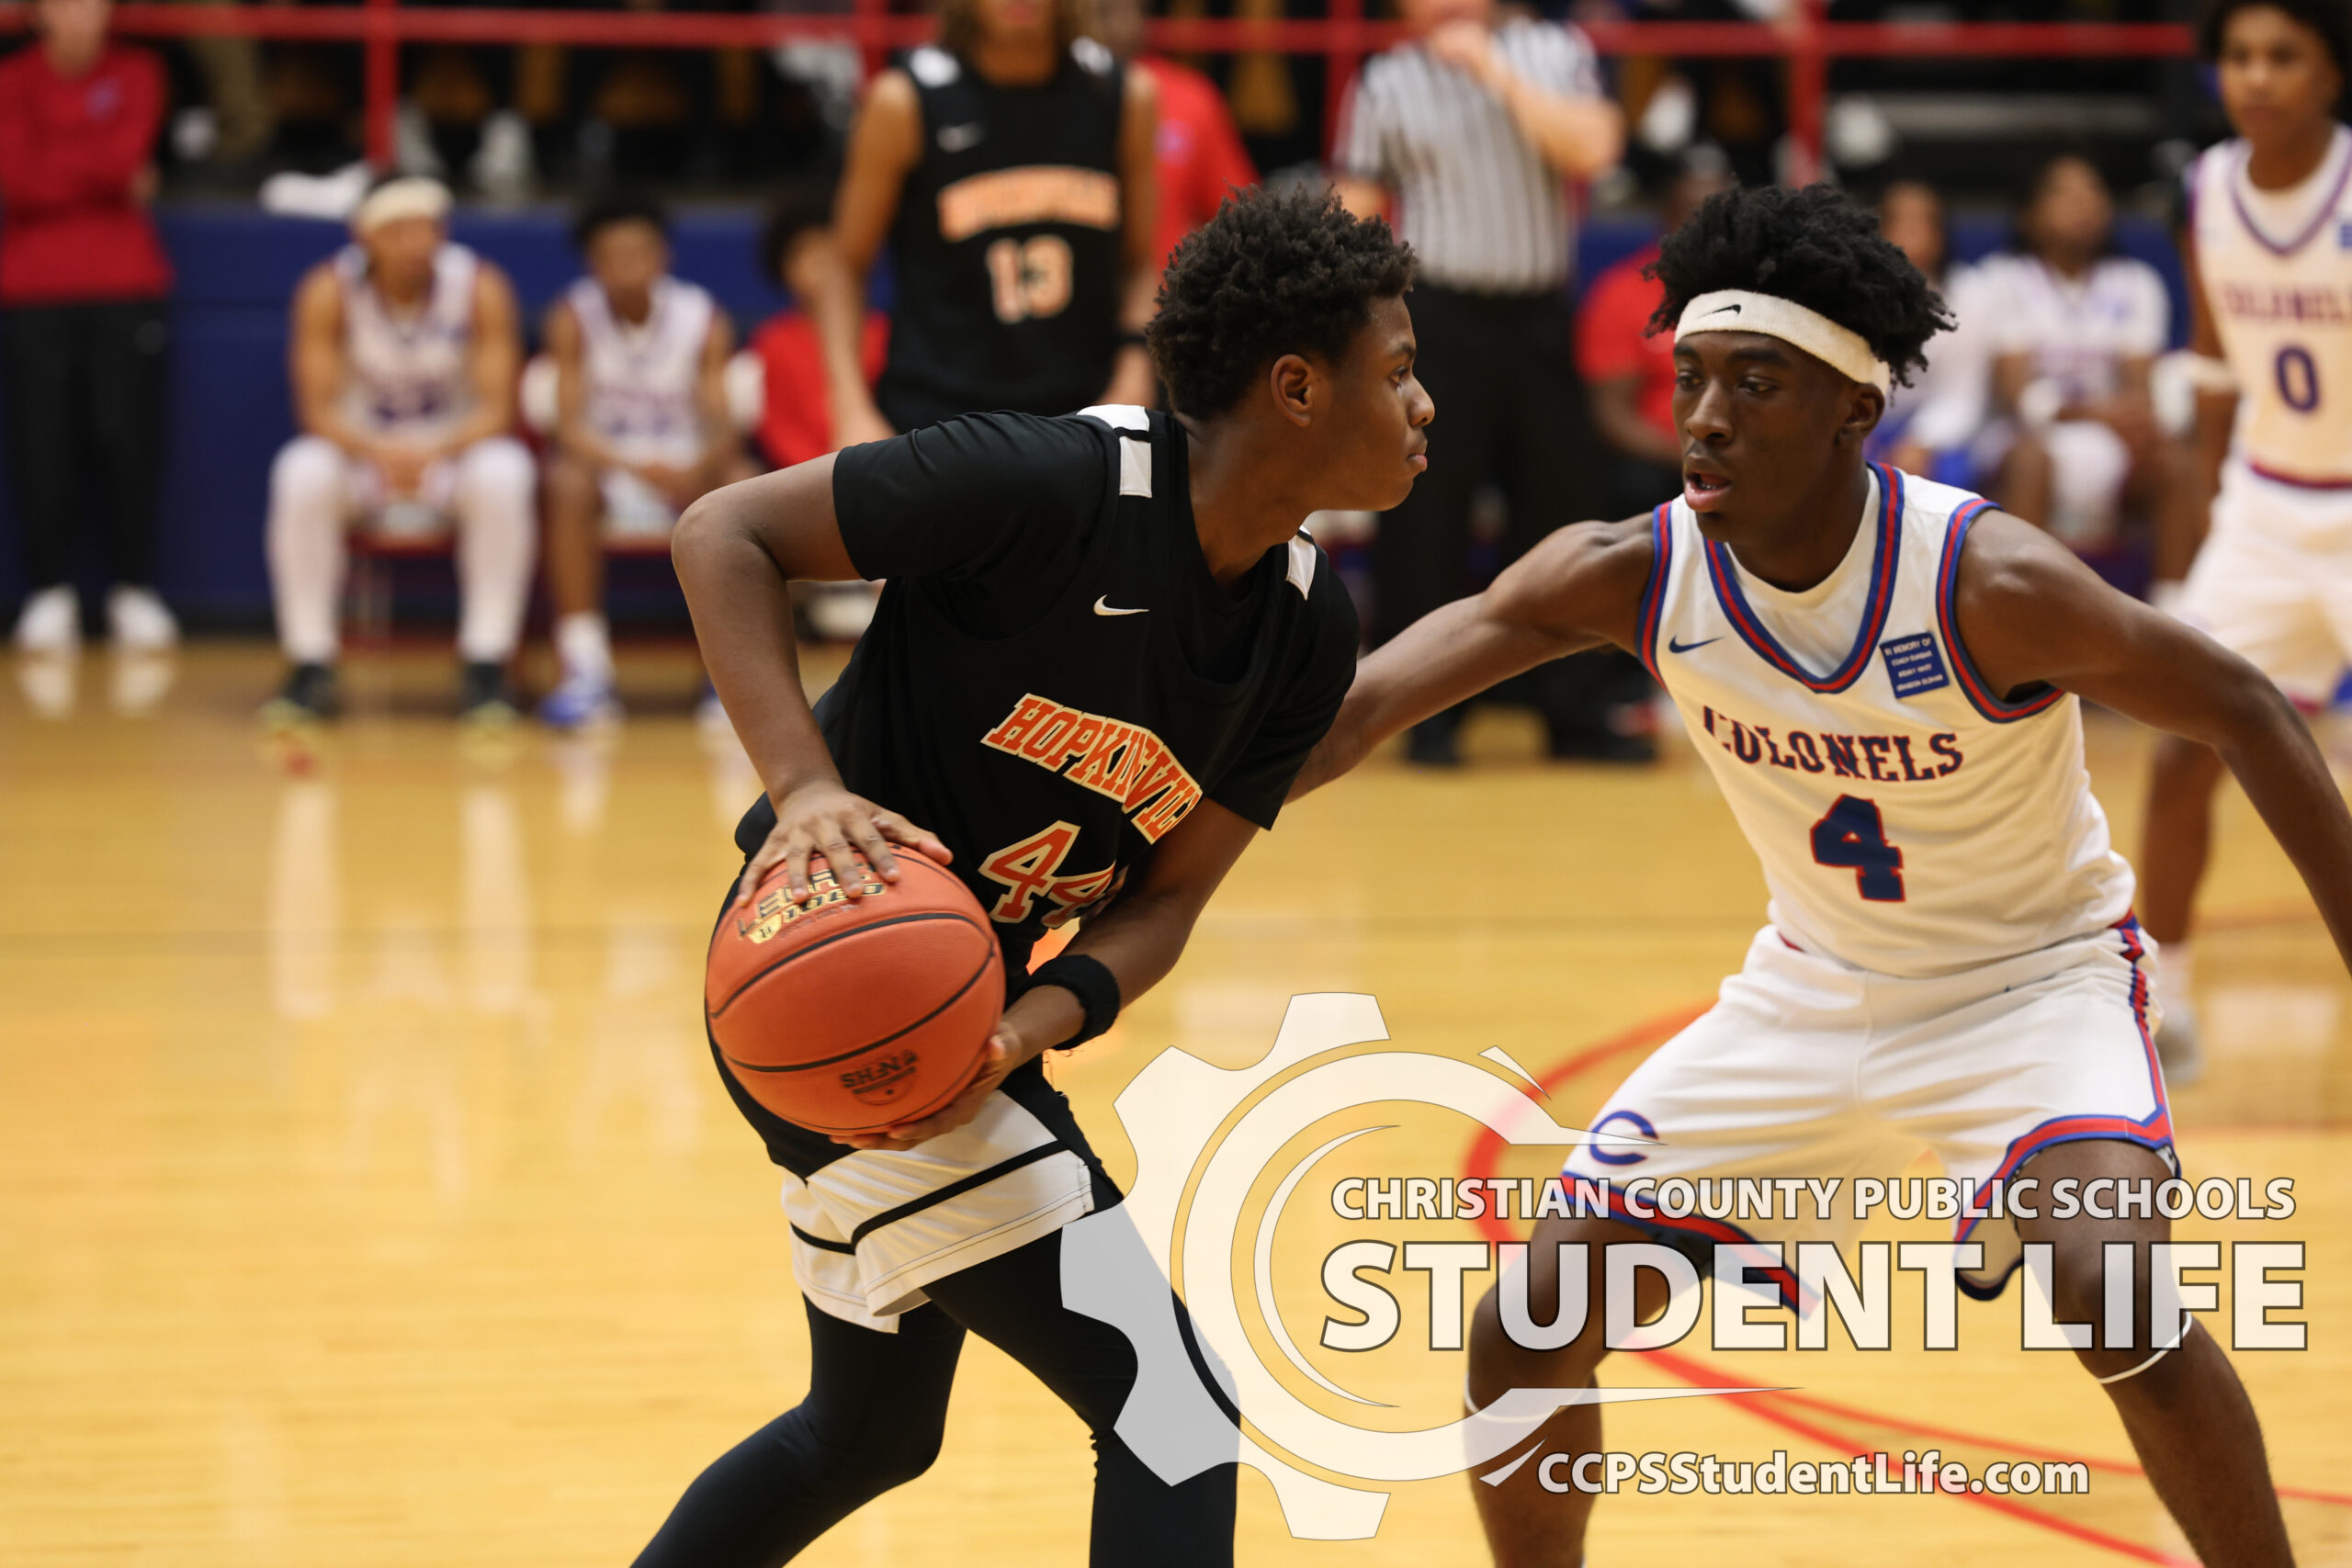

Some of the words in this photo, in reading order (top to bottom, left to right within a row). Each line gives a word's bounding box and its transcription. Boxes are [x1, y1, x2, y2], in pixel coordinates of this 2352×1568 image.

[986, 234, 1073, 323] 13
[2275, 343, 2320, 416] 0
[1921, 637, 1931, 647] OF
[978, 819, 1123, 928] 44
[1809, 793, 1906, 903] 4
[1589, 1110, 1659, 1166] C
